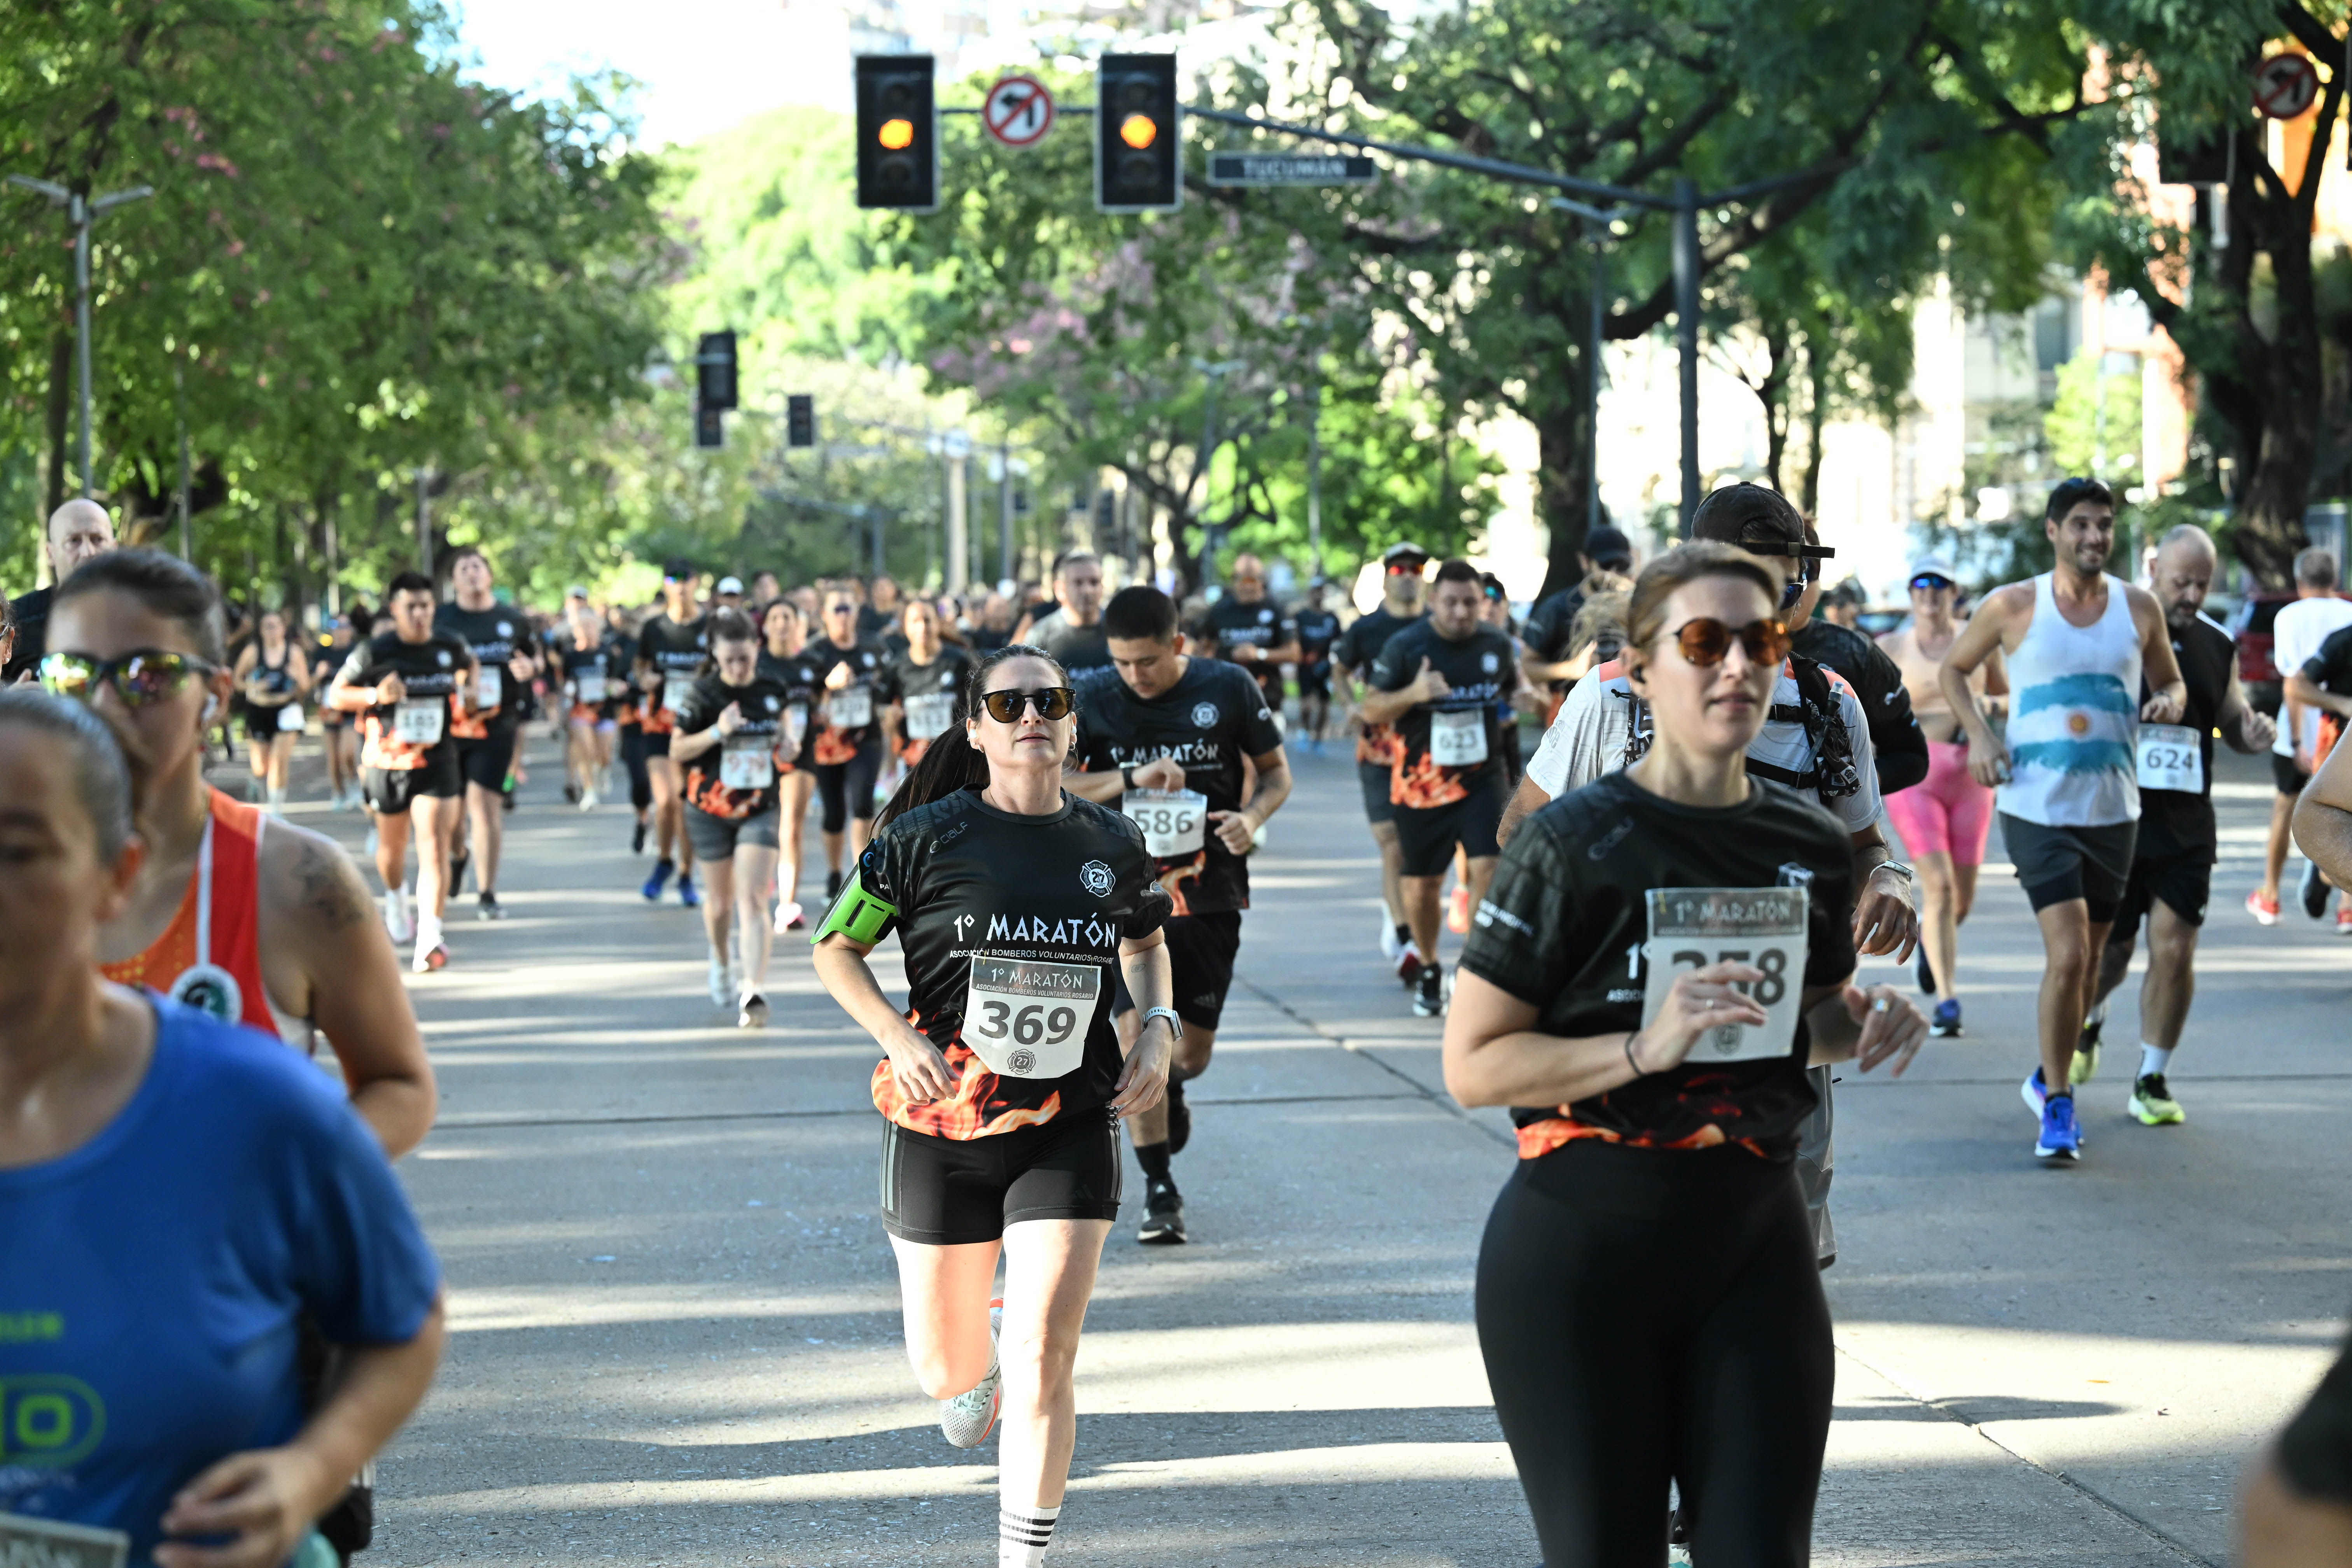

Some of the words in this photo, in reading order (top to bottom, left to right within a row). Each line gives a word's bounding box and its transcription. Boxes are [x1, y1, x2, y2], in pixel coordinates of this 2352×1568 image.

[2147, 748, 2193, 771] 624
[1135, 809, 1193, 834] 586
[1092, 871, 1105, 883] 27
[1699, 895, 1791, 922] MARATÓN
[986, 912, 1115, 948] MARATÓN
[949, 948, 989, 958] ASOCIACIÓN
[992, 949, 1036, 958] BOMBEROS
[1039, 950, 1092, 962] VOLUNTARIOS
[1009, 970, 1083, 989] MARATÓN
[976, 984, 1007, 993] ASOCIACIÓN
[1008, 987, 1036, 996] BOMBEROS
[1038, 990, 1071, 998] VOLUNTARIOS
[979, 1001, 1076, 1045] 369
[1017, 1057, 1028, 1066] 27
